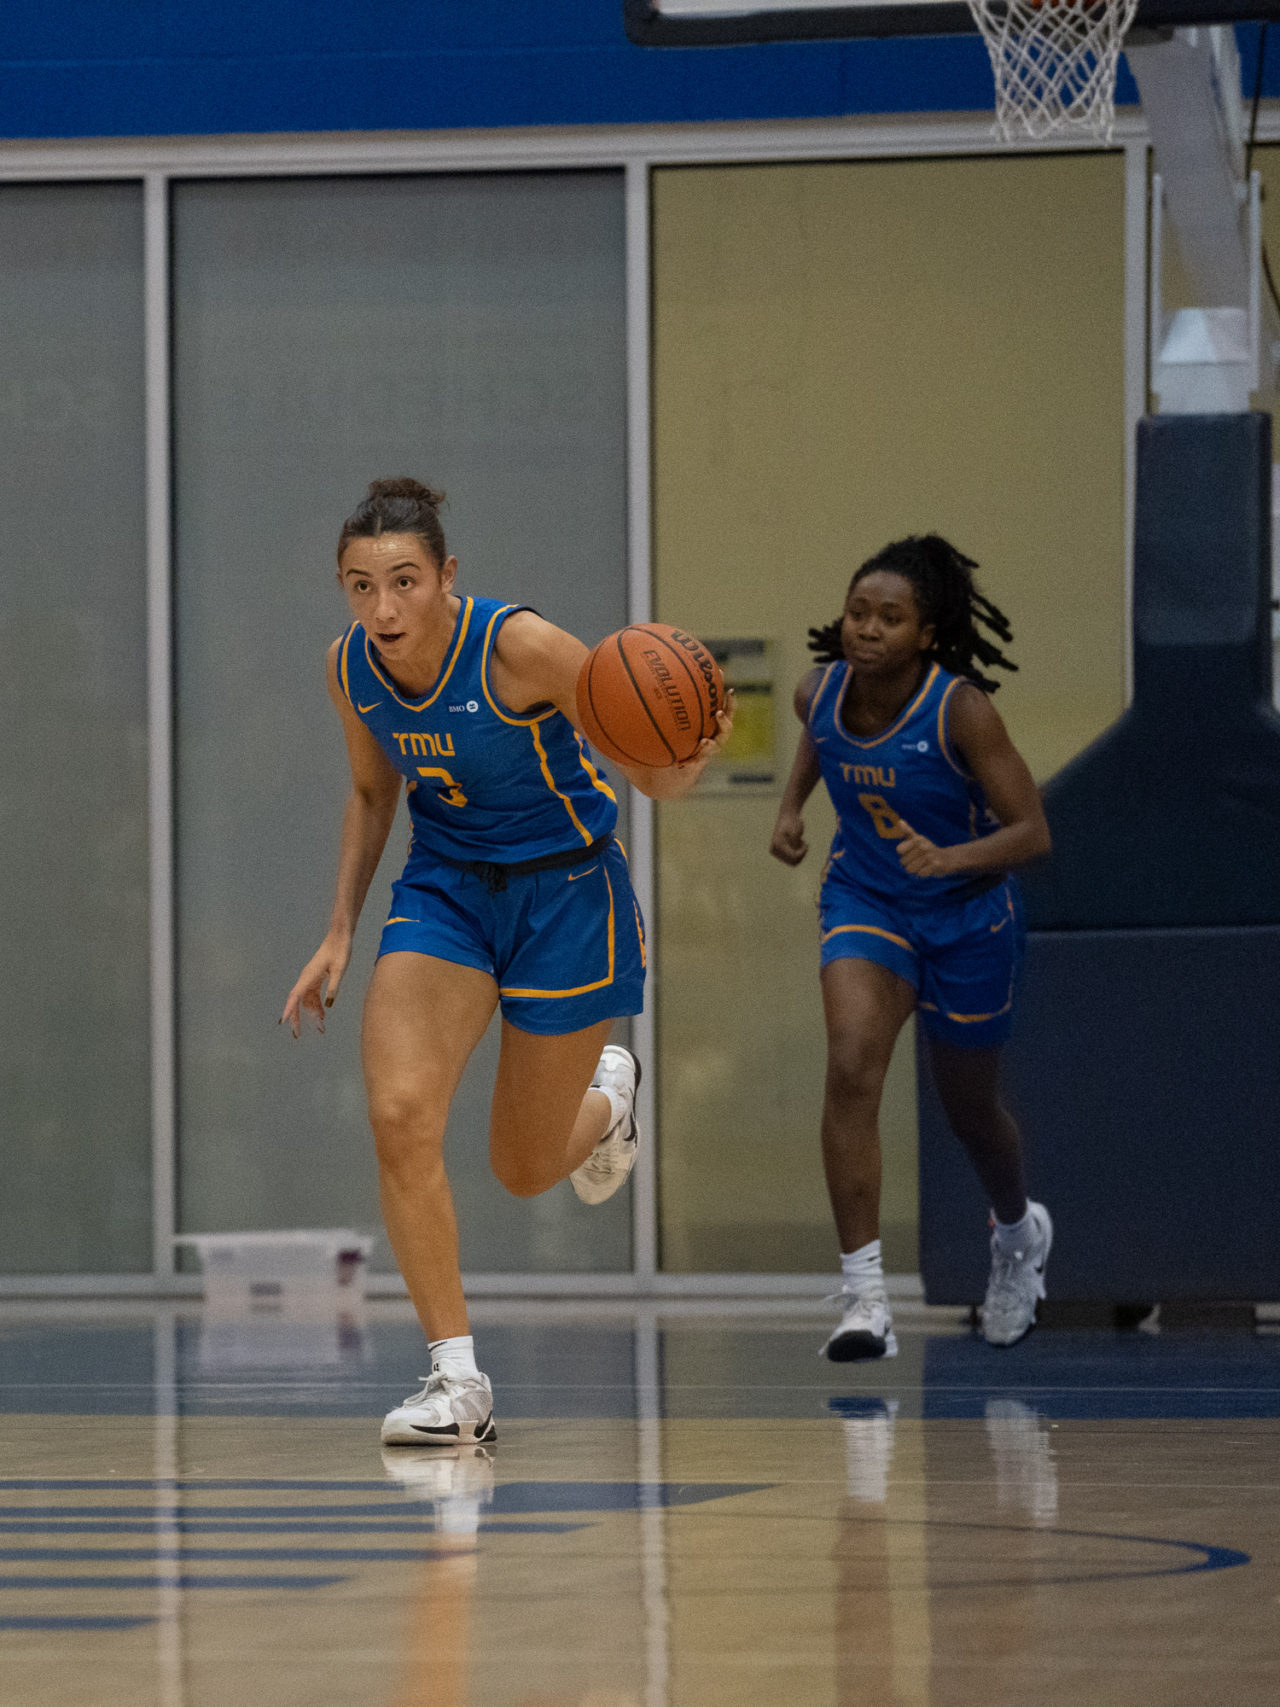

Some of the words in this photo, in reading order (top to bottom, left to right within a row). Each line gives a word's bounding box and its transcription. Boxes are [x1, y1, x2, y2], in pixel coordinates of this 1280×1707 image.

[642, 650, 691, 732] EVOLUTION
[392, 733, 455, 756] TMU
[840, 762, 896, 787] TMU
[858, 793, 906, 839] 8
